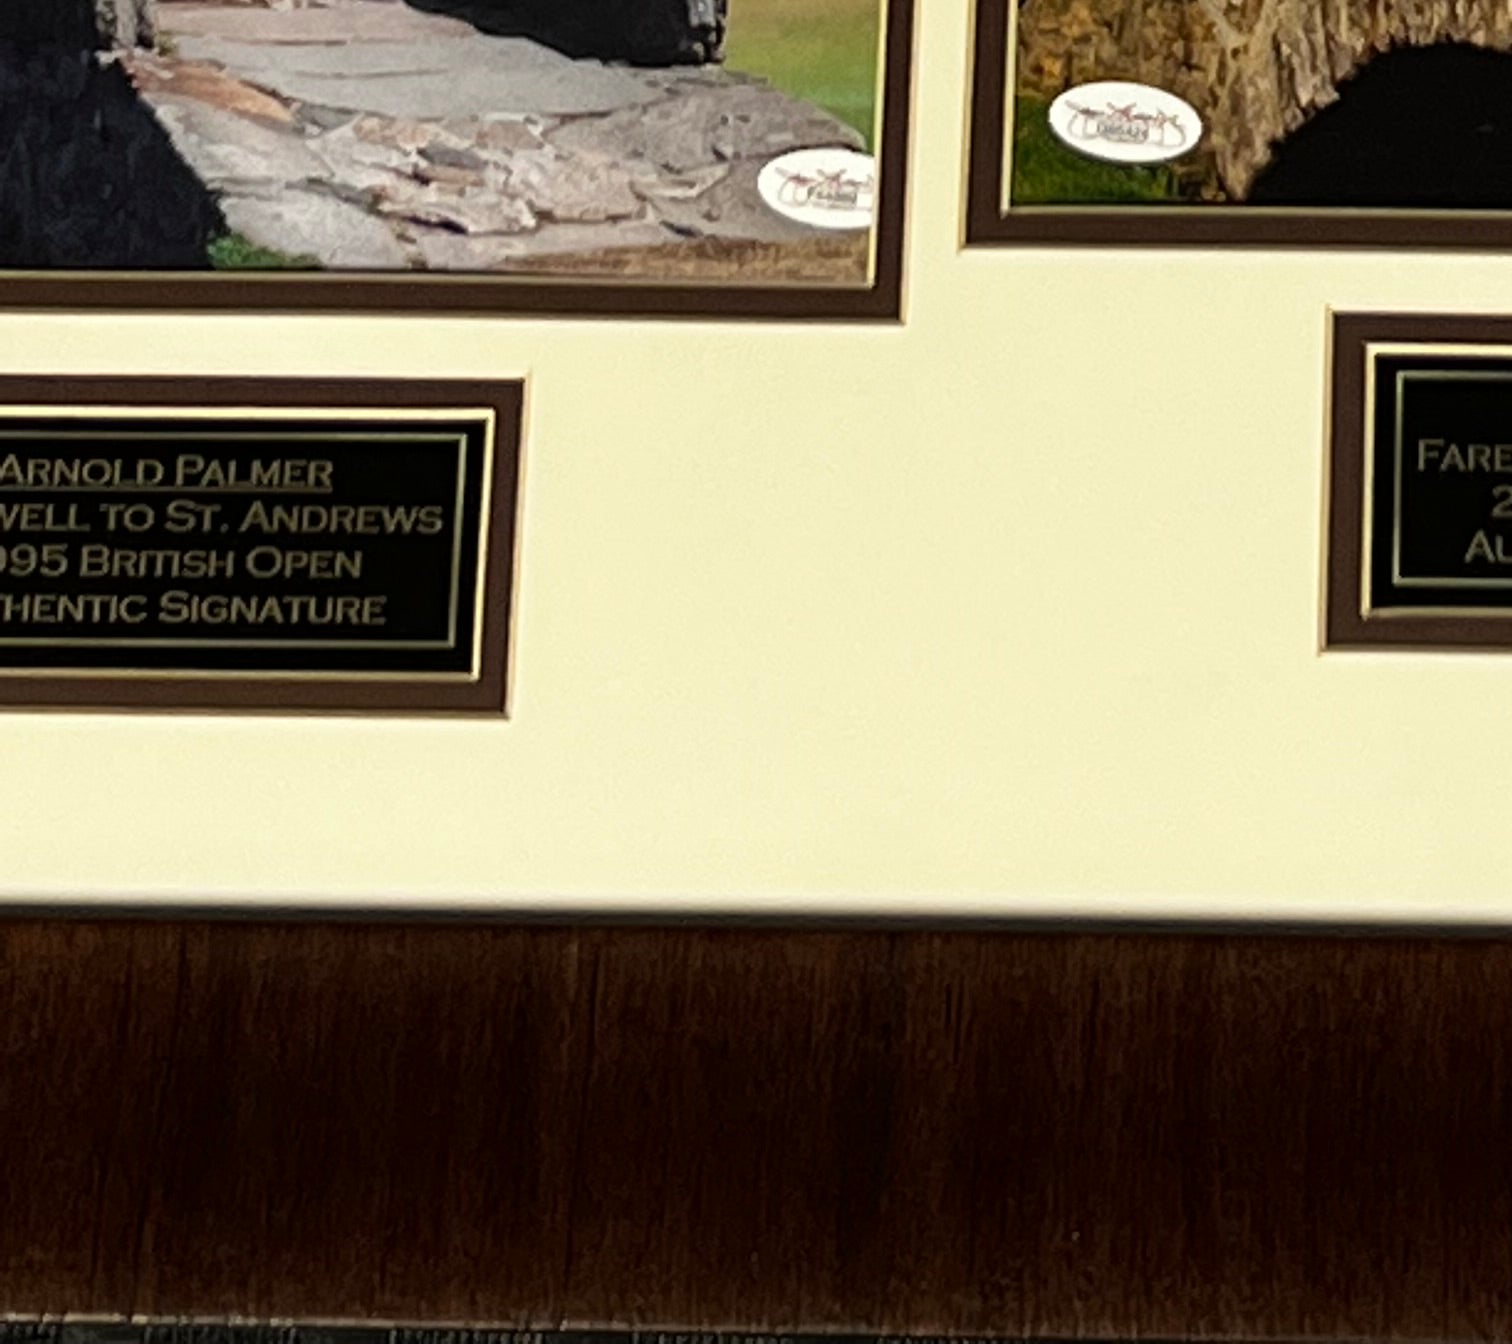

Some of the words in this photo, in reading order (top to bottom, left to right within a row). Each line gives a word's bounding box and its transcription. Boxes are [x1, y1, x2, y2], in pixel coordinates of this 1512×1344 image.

[174, 454, 335, 488] PALMER
[98, 502, 156, 533] TO
[238, 499, 444, 535] ANDREWS
[0, 542, 69, 578] 95
[78, 543, 236, 579] BRITISH
[244, 544, 364, 580] OPEN
[157, 589, 388, 626] SIGNATURE
